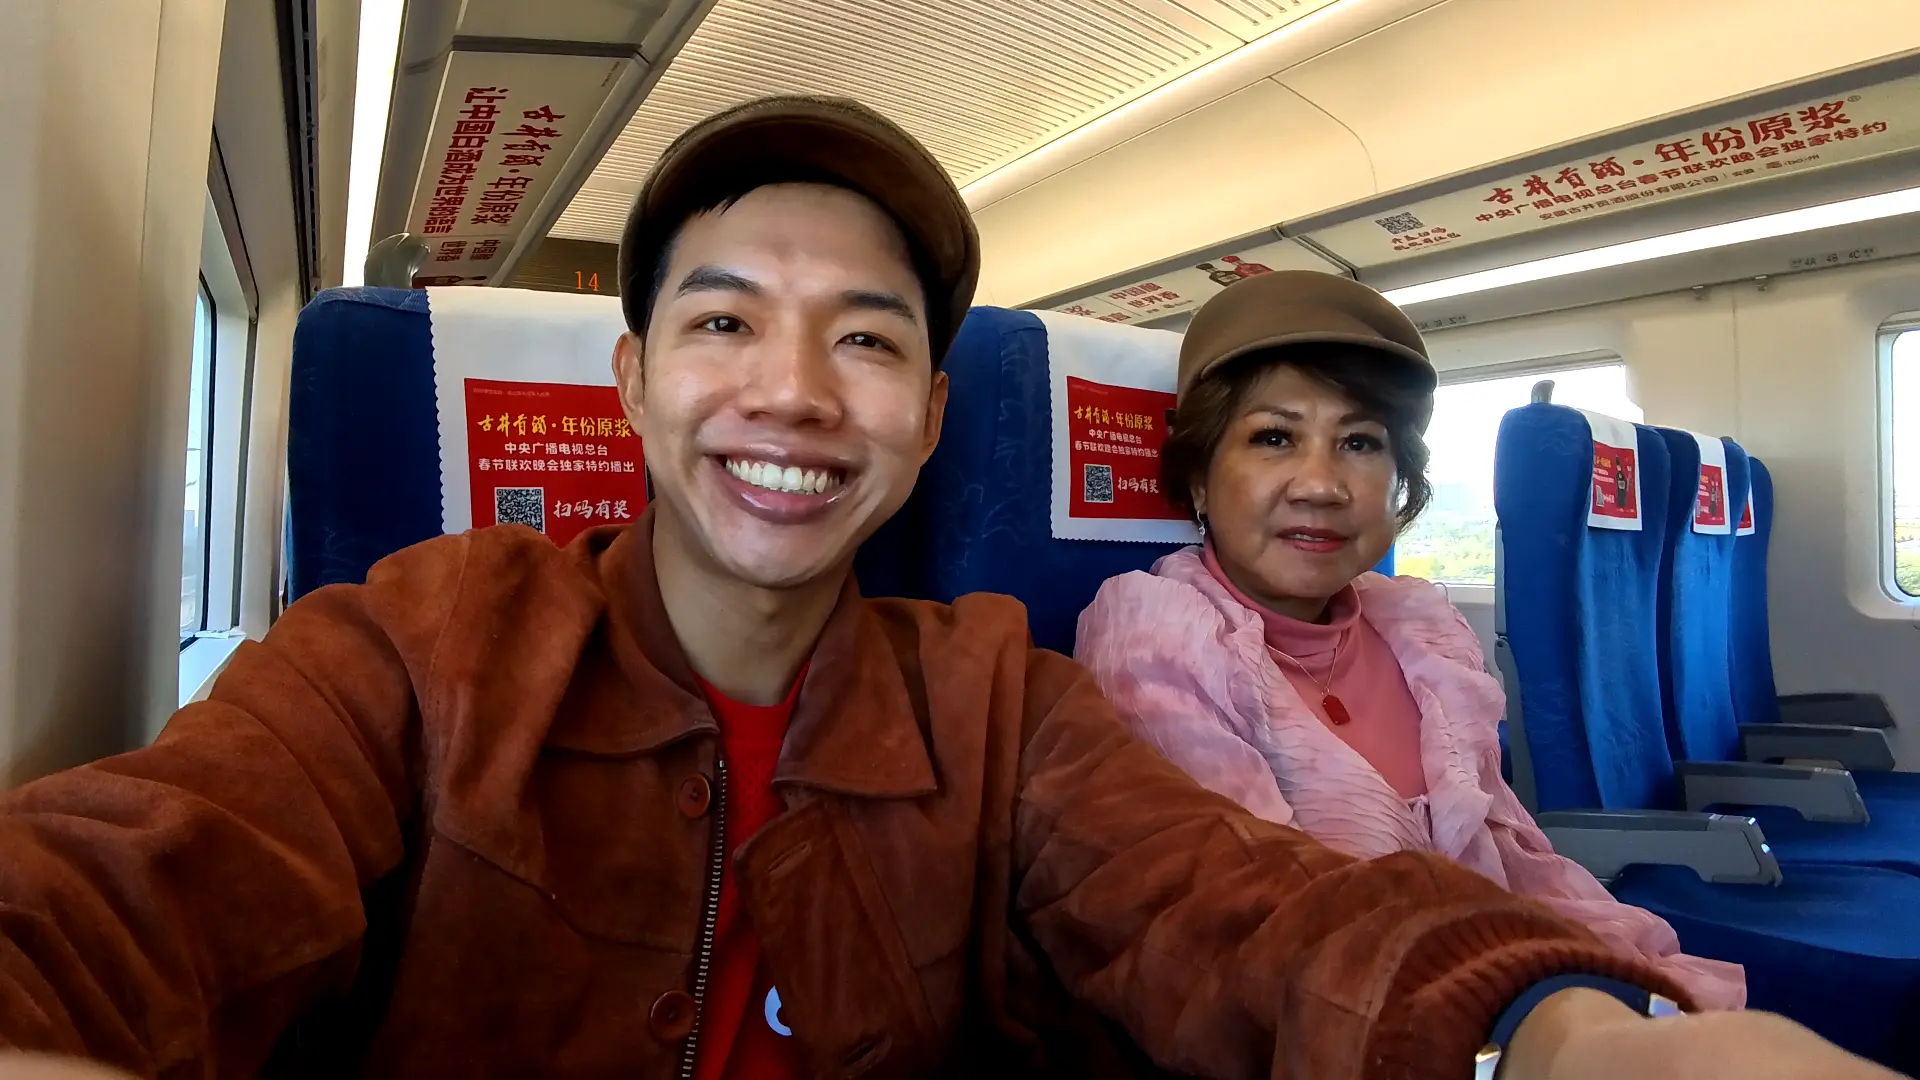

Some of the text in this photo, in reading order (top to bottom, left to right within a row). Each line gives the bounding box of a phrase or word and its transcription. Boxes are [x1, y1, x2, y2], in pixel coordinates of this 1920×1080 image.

[423, 87, 508, 233] 让中国白酒成为世界的语言
[575, 270, 599, 291] 14
[1088, 428, 1142, 444] 中央广播电视总台
[504, 442, 608, 456] 中央广播电视总台
[1074, 440, 1158, 458] 春节联欢晚会独家特约播出
[478, 458, 635, 473] 春节联欢晚会独家特约播出
[1117, 477, 1159, 494] 扫码有奖
[553, 500, 631, 519] 扫码有奖
